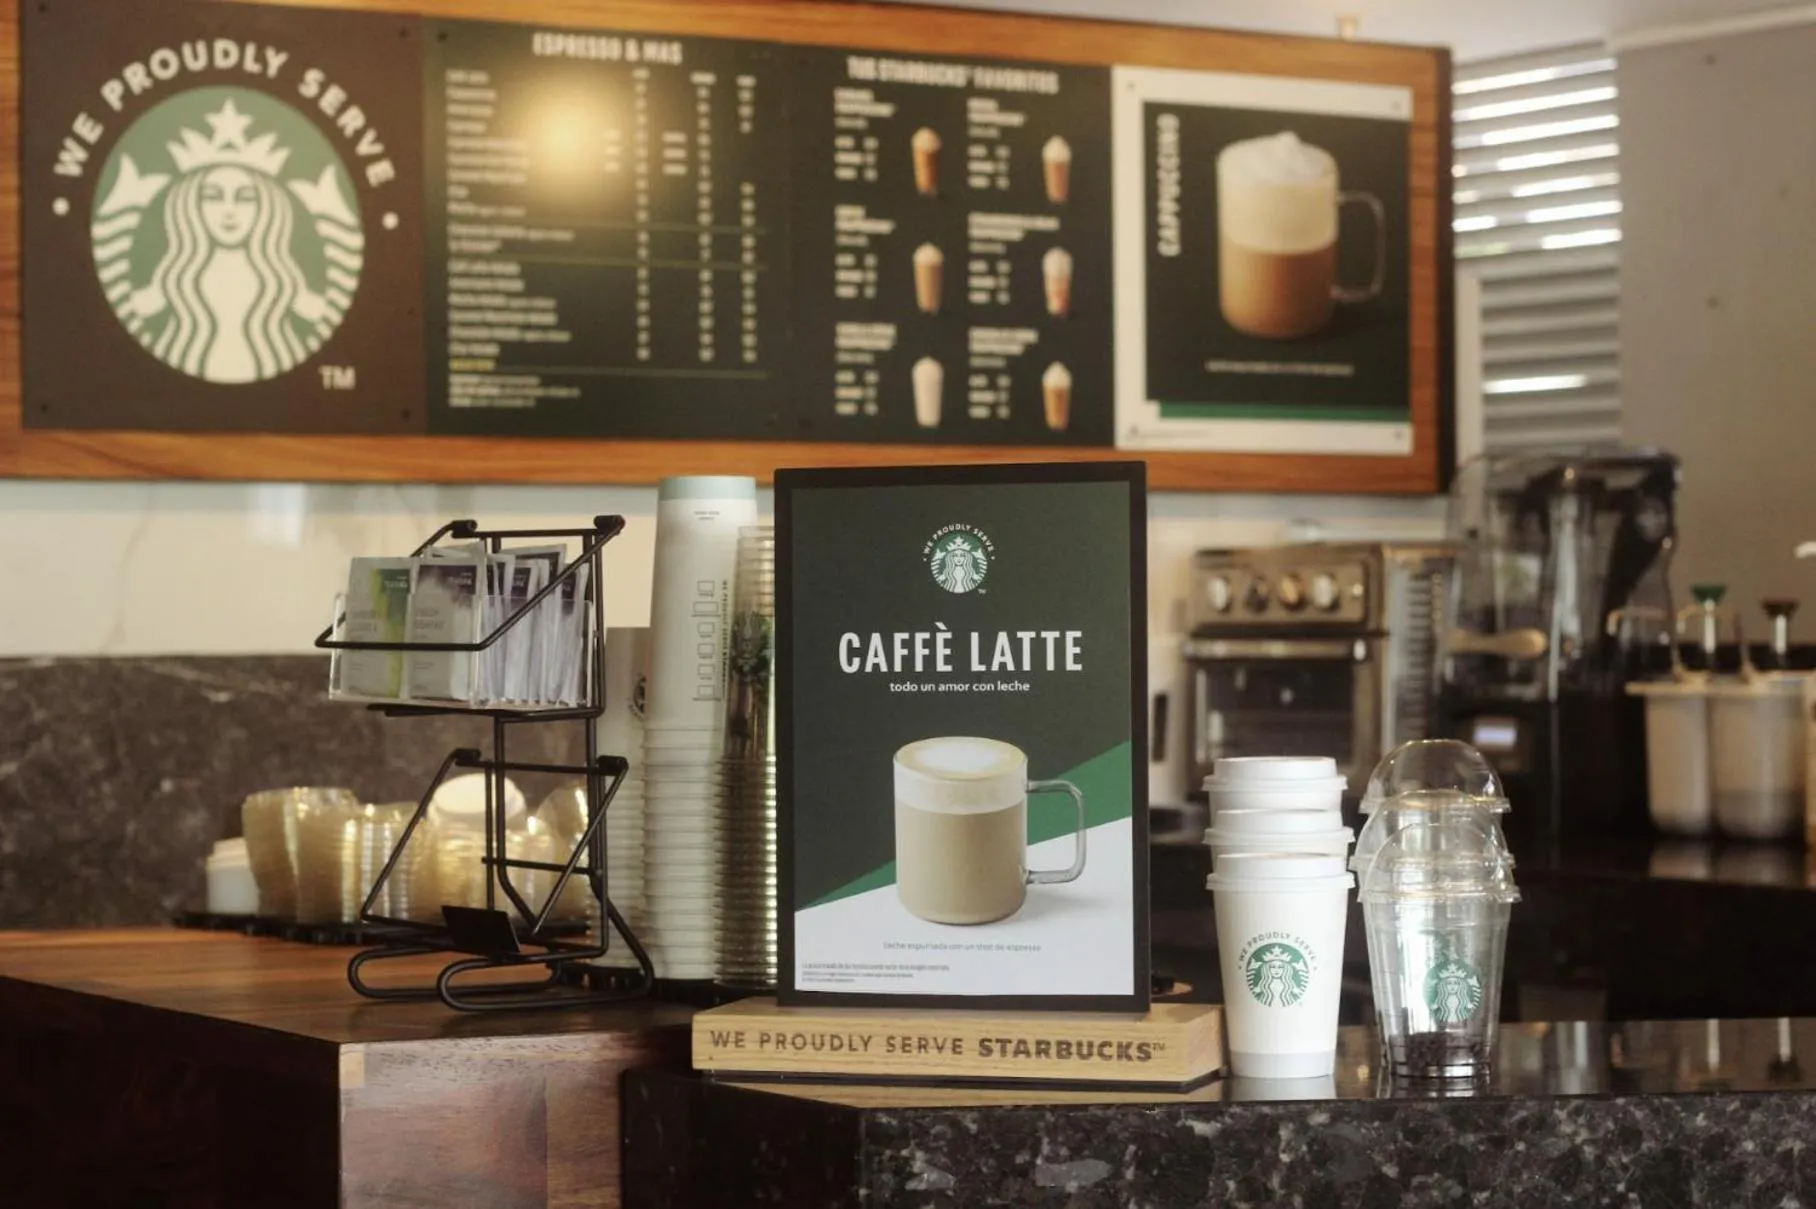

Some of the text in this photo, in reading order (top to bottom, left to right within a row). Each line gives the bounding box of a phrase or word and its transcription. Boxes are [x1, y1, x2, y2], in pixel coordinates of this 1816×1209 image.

[53, 38, 396, 188] WE PROUDLY SERVE
[932, 523, 972, 540] PROUDLY
[973, 528, 994, 552] SERVE
[839, 621, 1083, 674] CAFFÈ LATTE
[889, 680, 1031, 692] todo un amor con leche
[710, 1030, 746, 1049] WE
[759, 1032, 873, 1053] PROUDLY
[886, 1035, 963, 1056] SERVE
